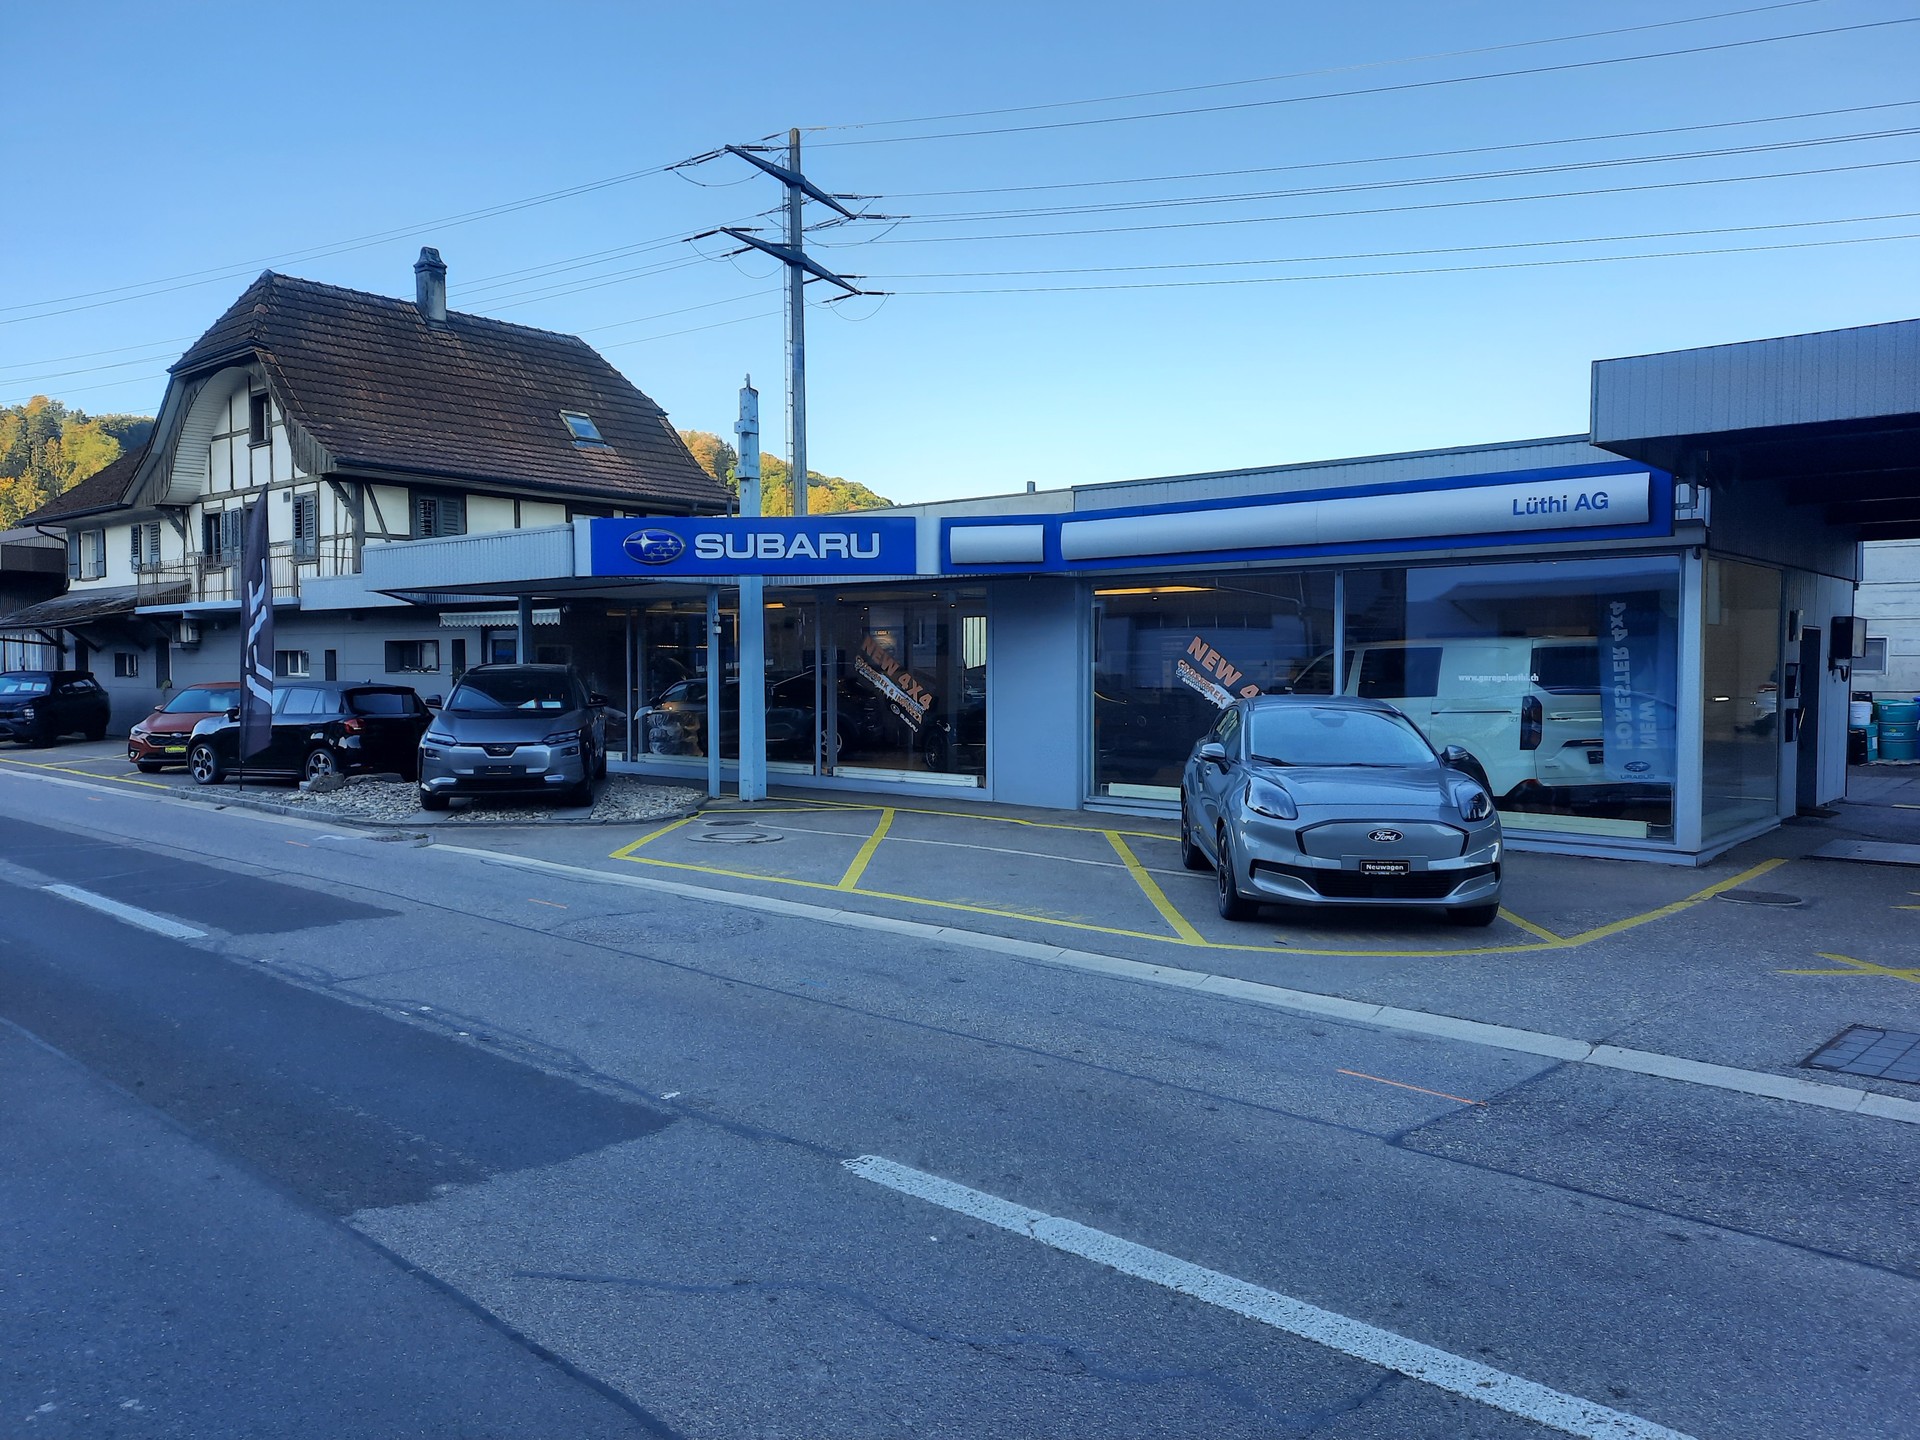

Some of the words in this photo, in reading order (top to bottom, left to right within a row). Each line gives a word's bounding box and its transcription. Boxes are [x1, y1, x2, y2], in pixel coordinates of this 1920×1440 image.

[1512, 495, 1567, 517] Lüthi
[1574, 491, 1610, 511] AG
[695, 533, 880, 559] SUBARU
[861, 635, 901, 677] NEW
[897, 672, 934, 710] 4X4
[1186, 635, 1243, 688] NEW
[1374, 831, 1397, 841] Ford
